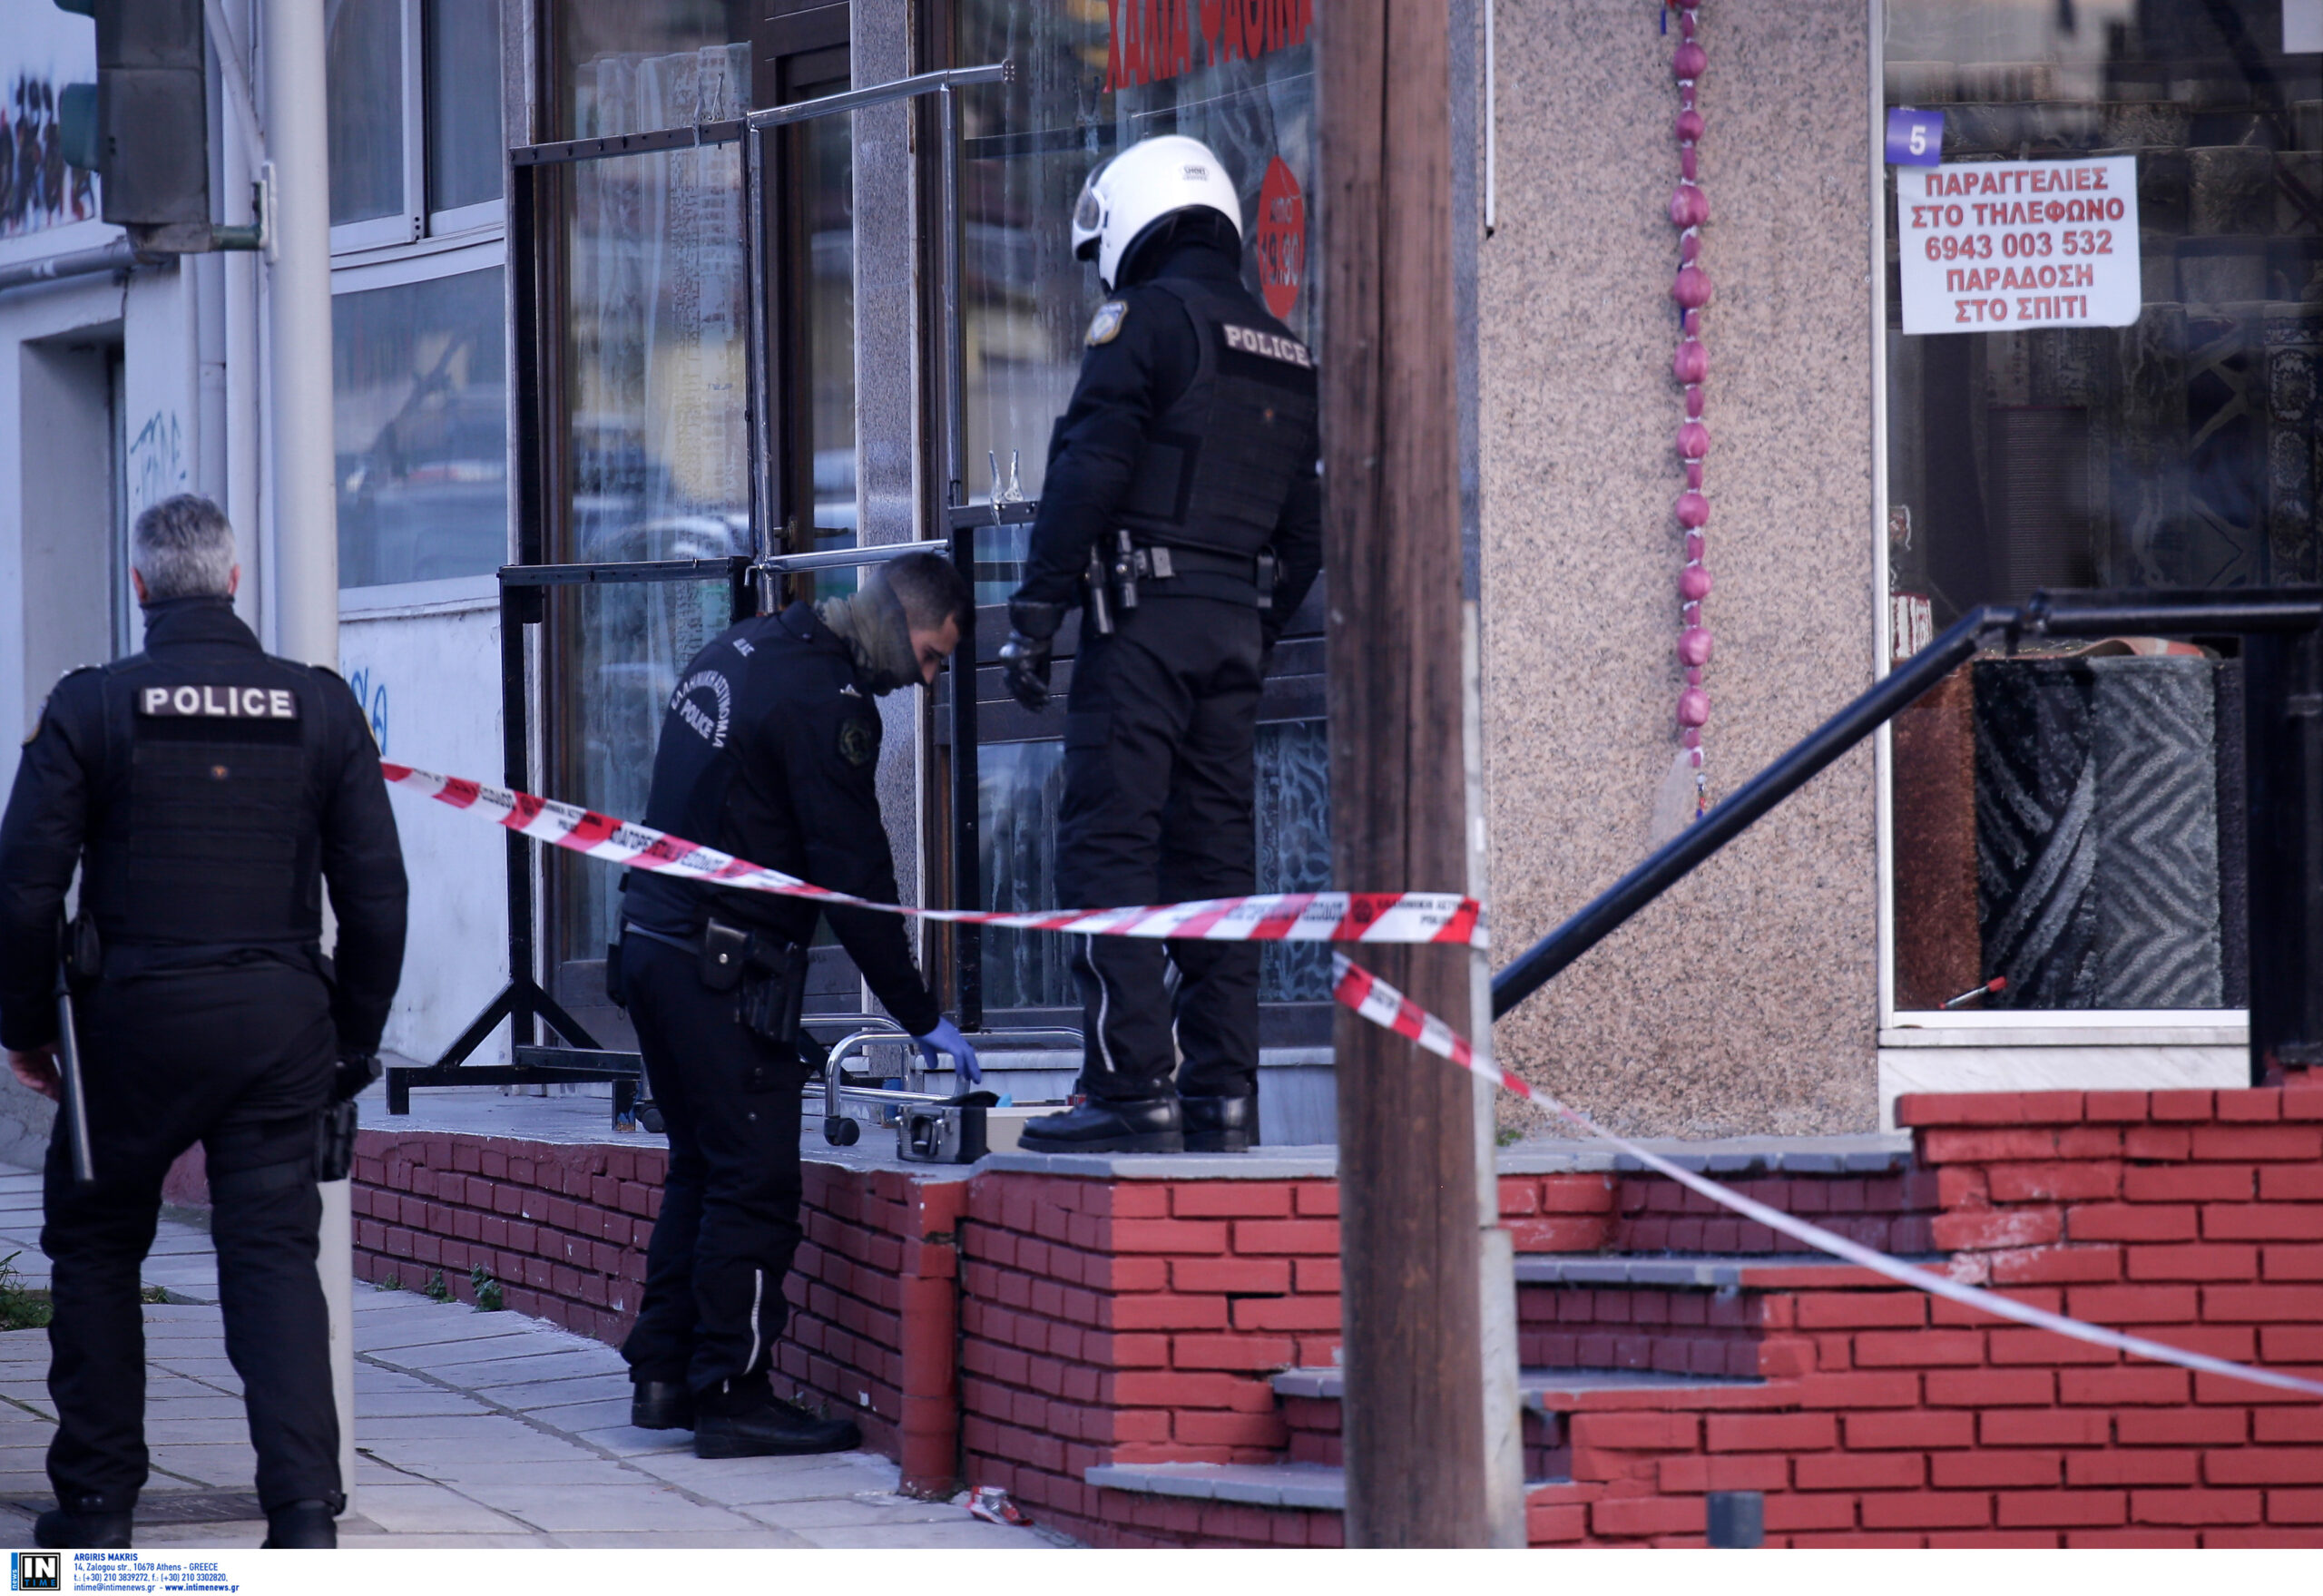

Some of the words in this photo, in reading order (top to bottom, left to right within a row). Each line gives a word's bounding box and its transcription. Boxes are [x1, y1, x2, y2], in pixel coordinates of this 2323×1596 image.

[1909, 124, 1926, 155] 5
[1925, 167, 2108, 197] ΠΑΡΑΓΓΕΛΙΕΣ
[1911, 204, 1964, 228] ΣΤΟ
[1972, 198, 2124, 225] ΤΗΛΕΦΩΝΟ
[1925, 234, 1993, 260] 6943
[2002, 232, 2053, 258] 003
[2062, 230, 2112, 255] 532
[1946, 264, 2093, 292] ΠΑΡΑΔΟΣΗ
[1955, 299, 2007, 323] ΣΤΟ
[2016, 295, 2087, 320] ΣΠΙΤΙ
[1224, 324, 1311, 368] POLICE
[145, 687, 293, 717] POLICE
[680, 698, 715, 739] POLICE
